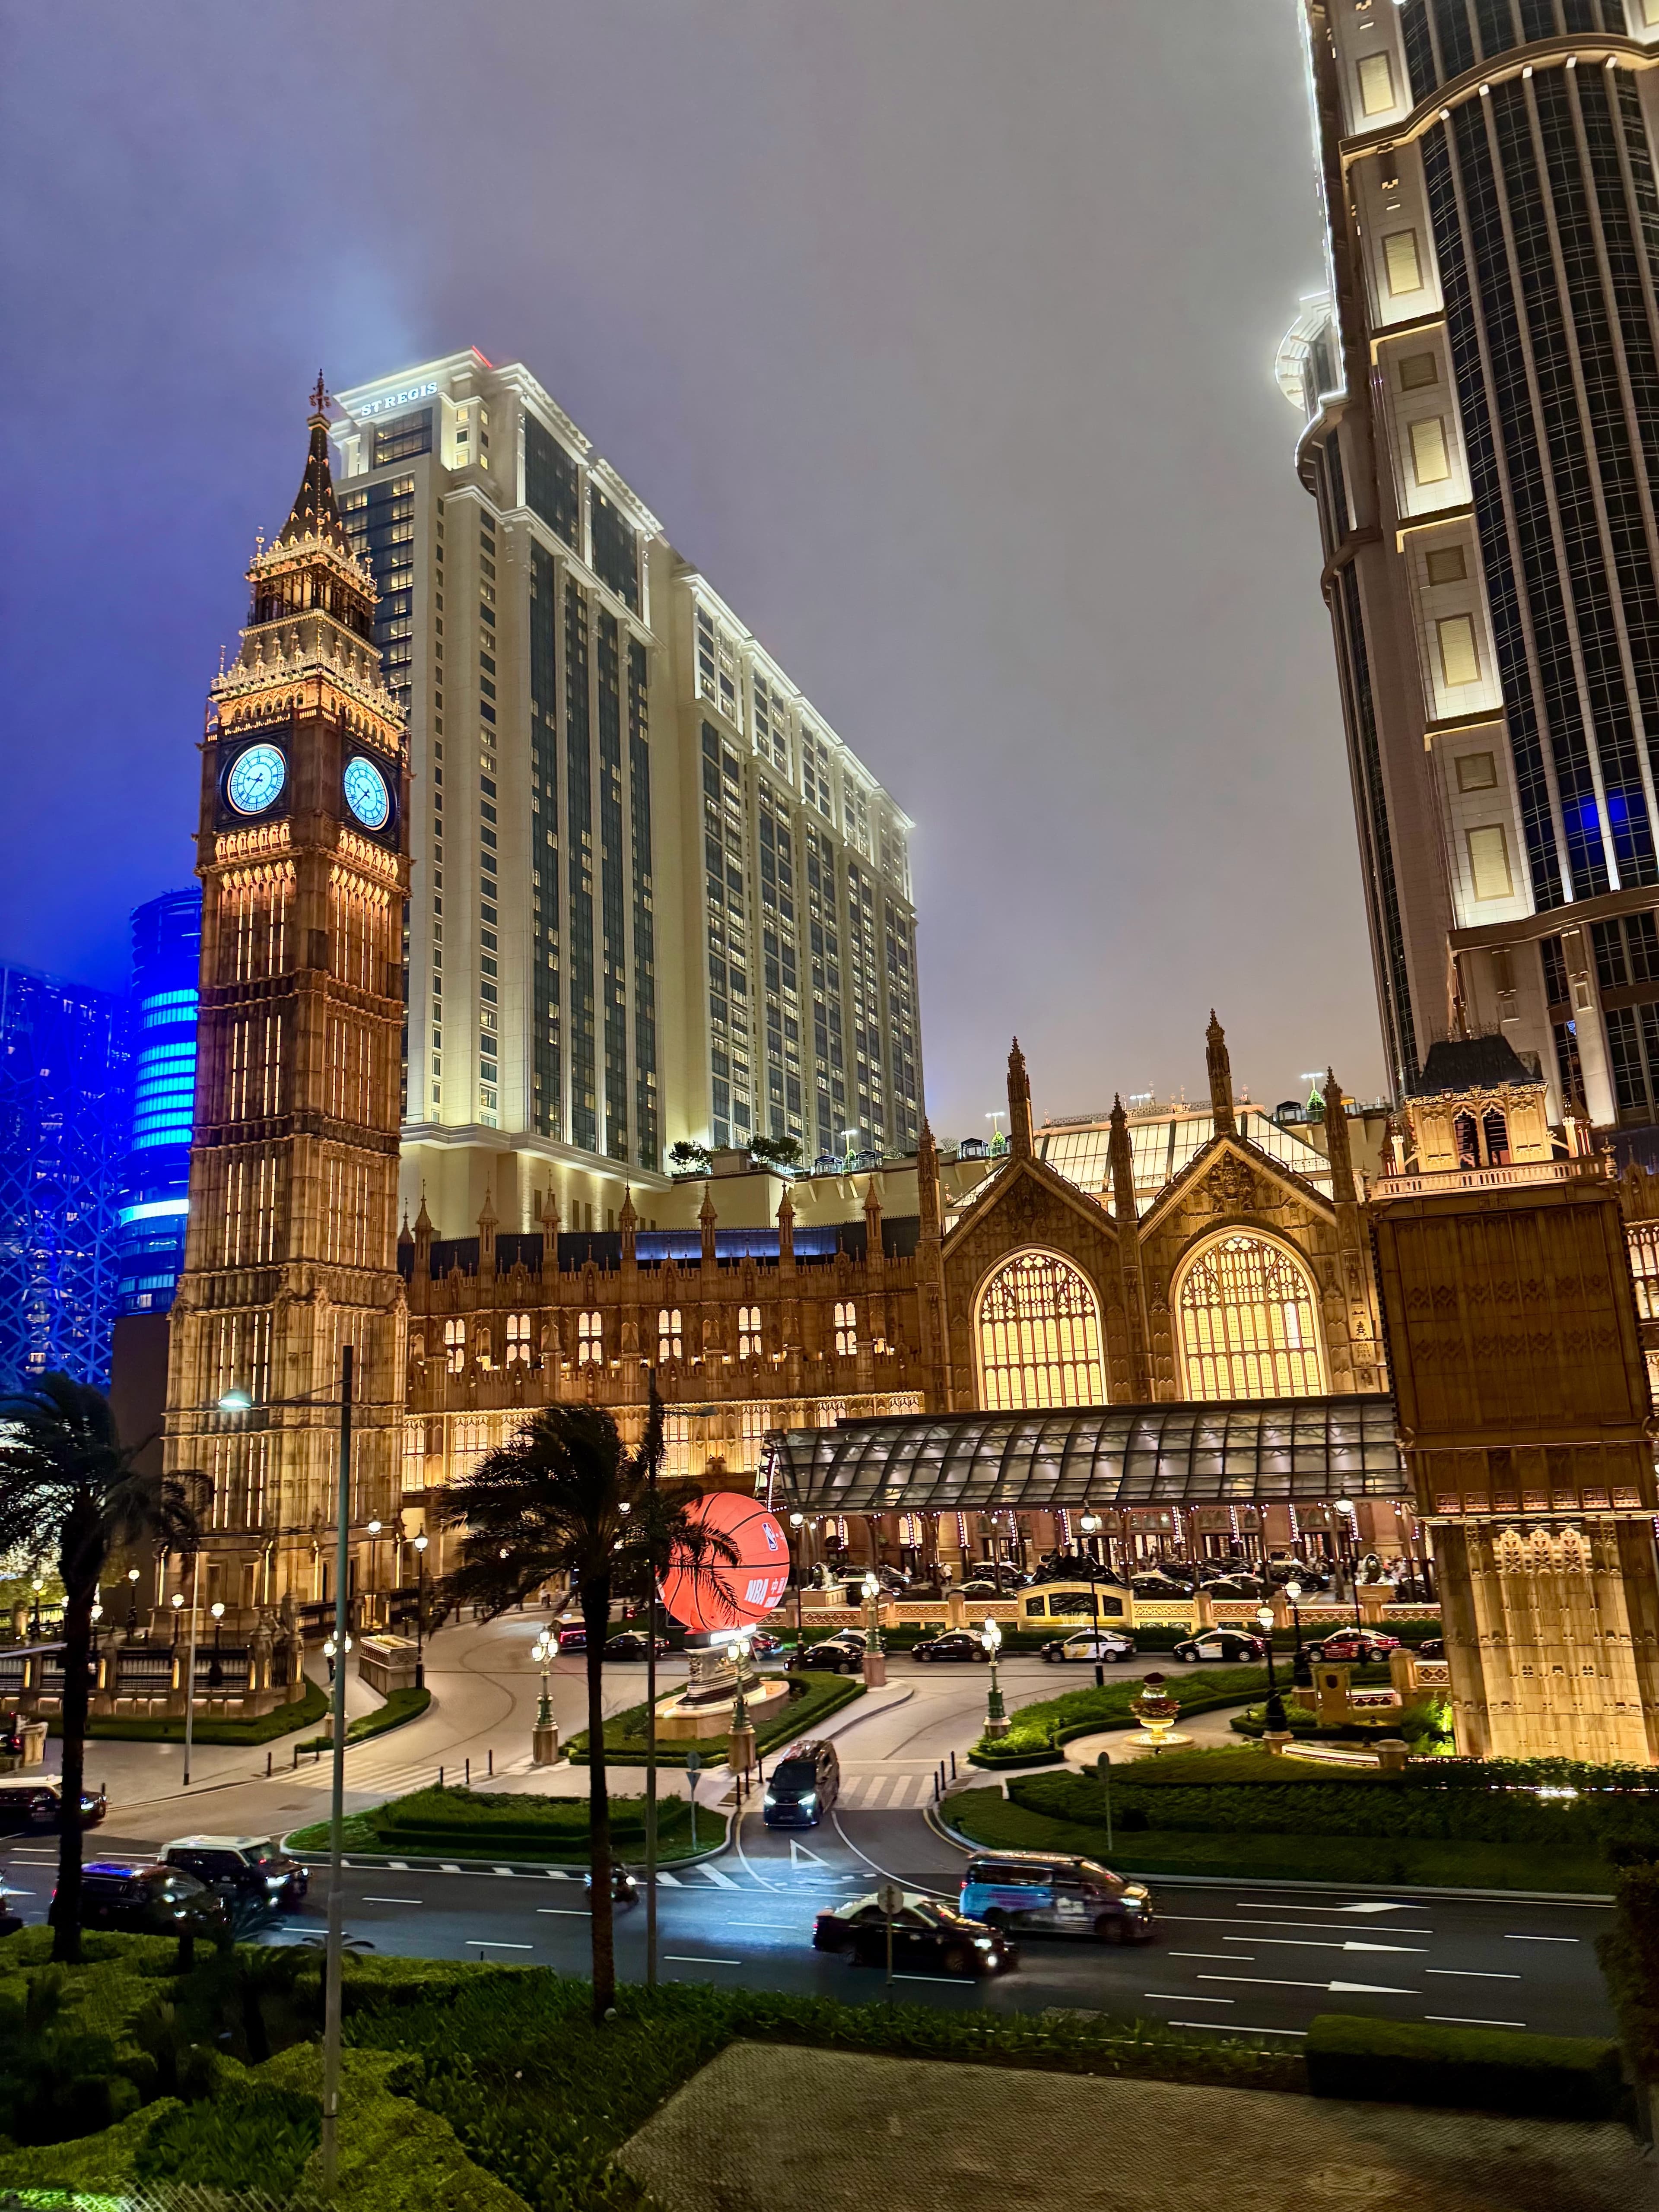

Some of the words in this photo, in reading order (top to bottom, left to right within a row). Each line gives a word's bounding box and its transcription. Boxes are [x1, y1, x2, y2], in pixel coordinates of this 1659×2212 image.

[361, 400, 382, 416] ST
[384, 382, 437, 408] REGIS
[744, 1578, 769, 1606] NBA
